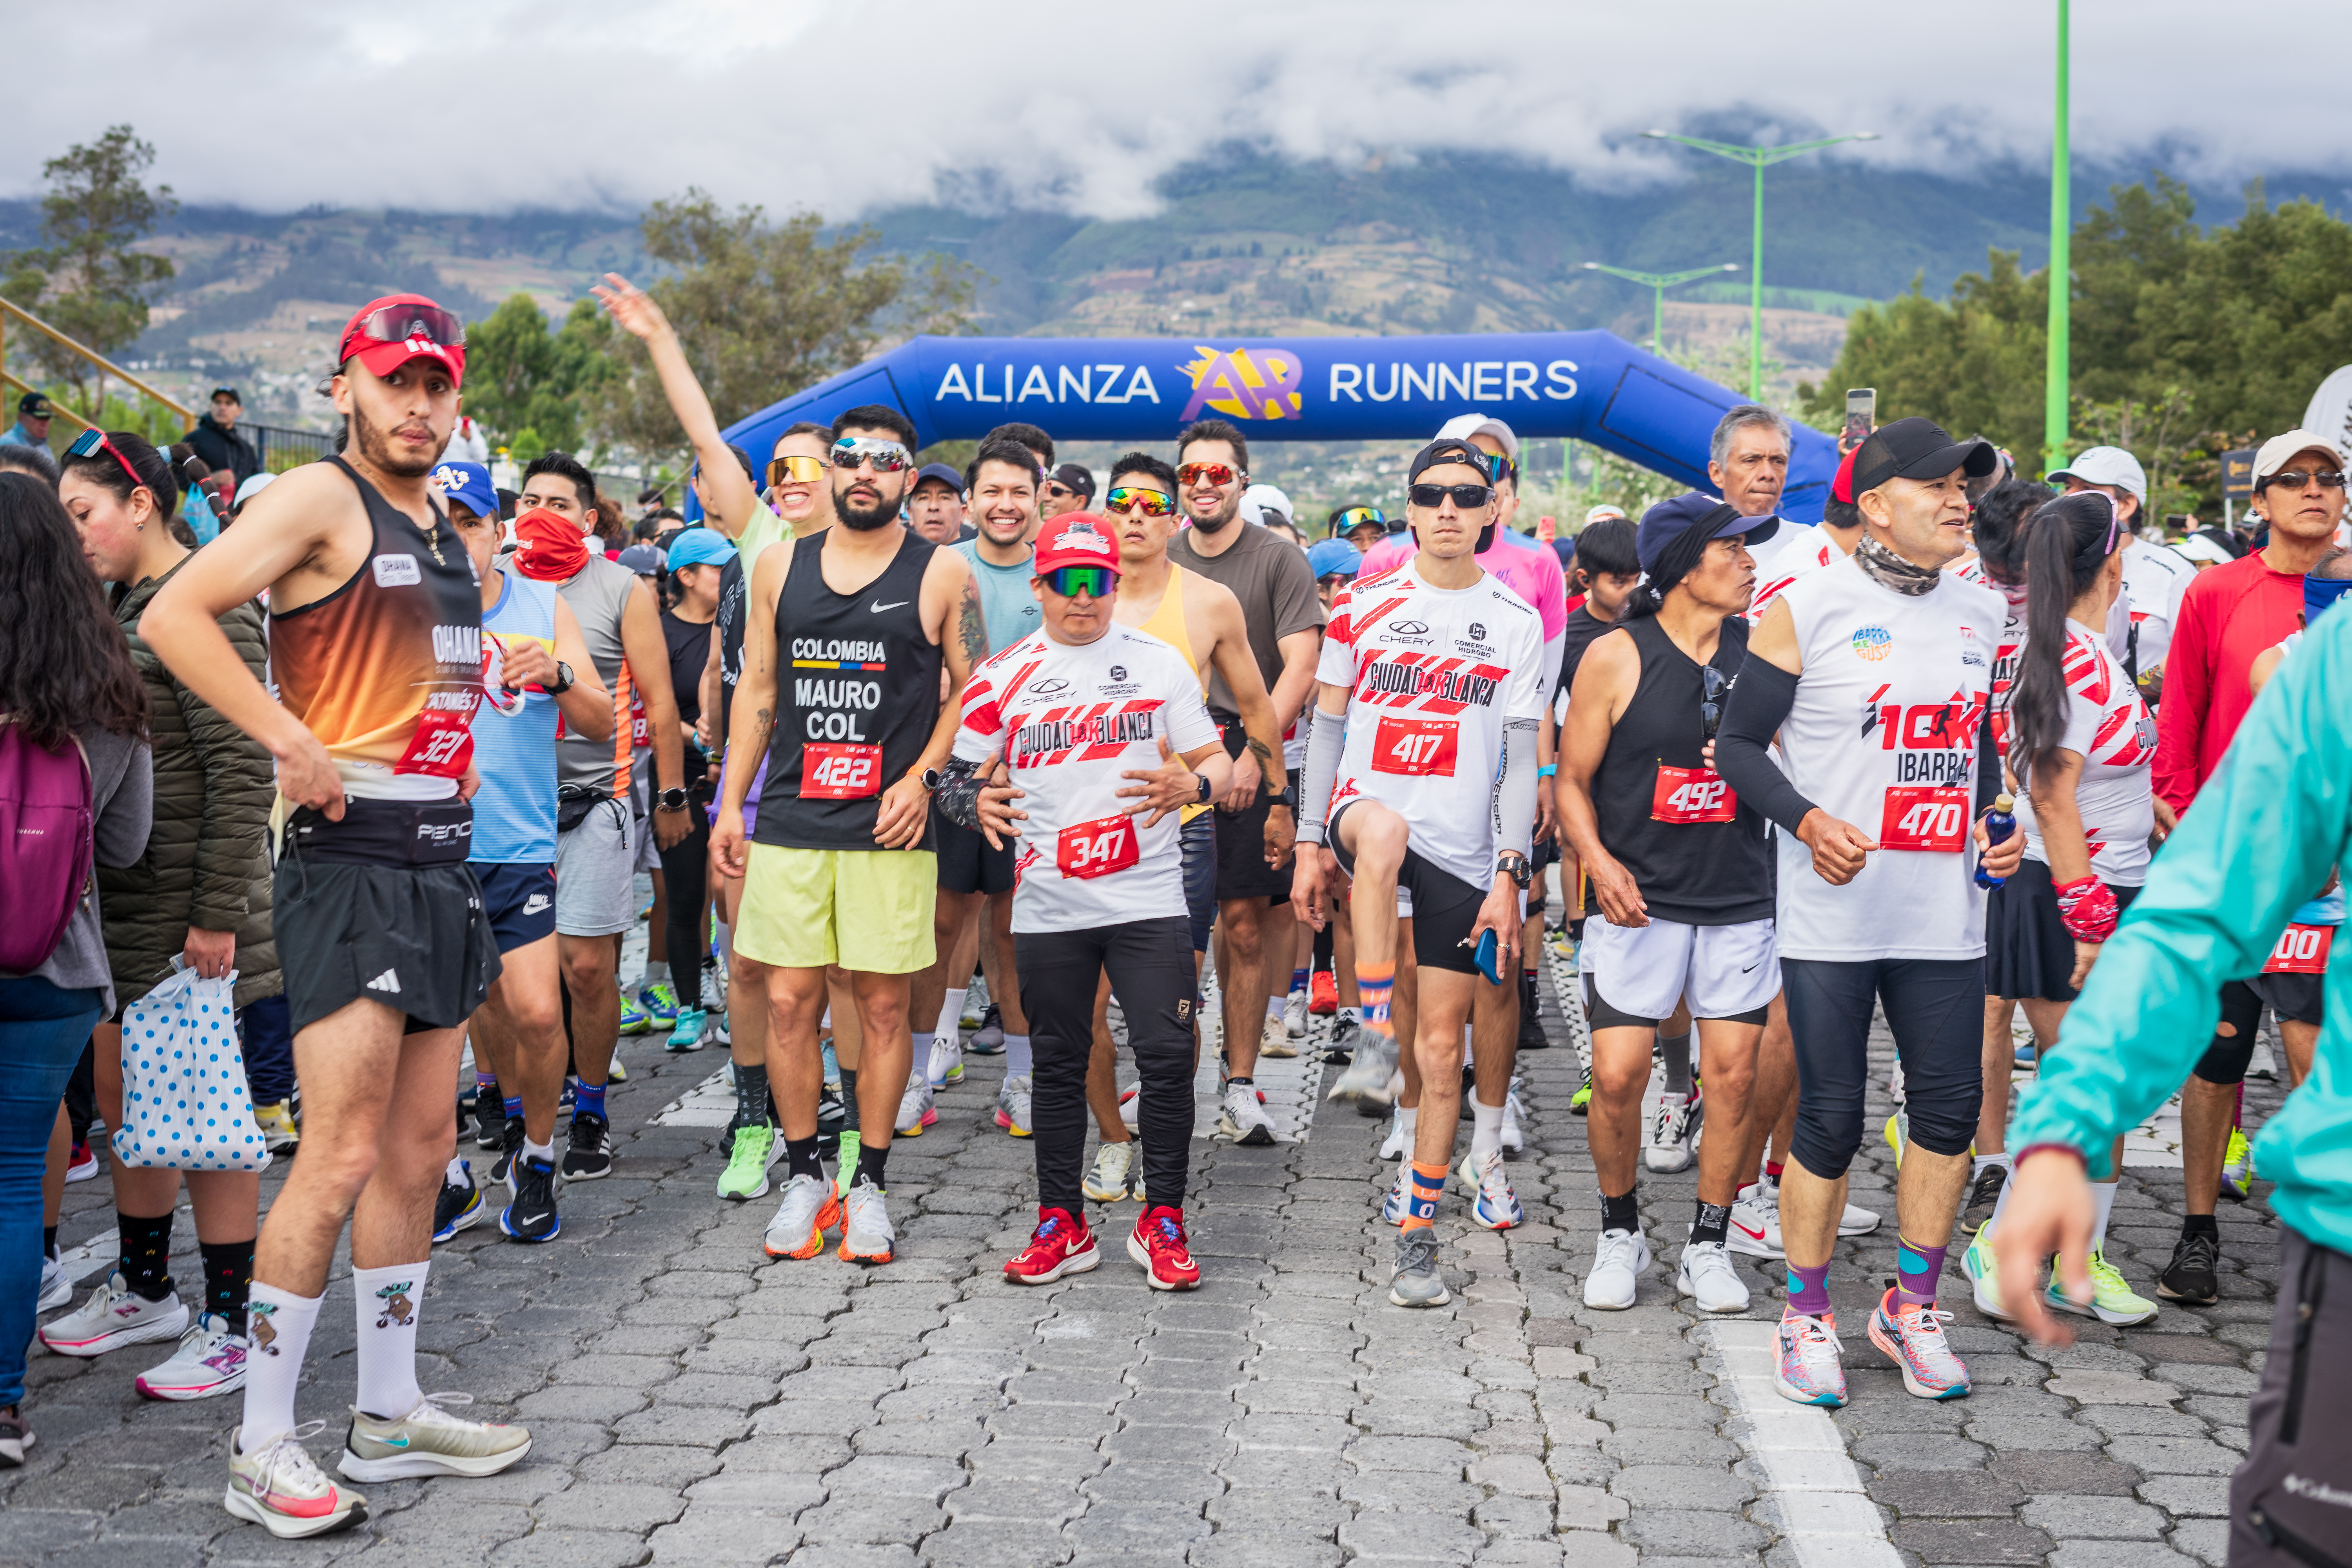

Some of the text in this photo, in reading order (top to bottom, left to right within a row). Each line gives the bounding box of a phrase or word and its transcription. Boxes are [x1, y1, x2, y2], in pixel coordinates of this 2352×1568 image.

[935, 363, 1160, 404] ALIANZA
[1329, 360, 1579, 403] RUNNERS
[436, 465, 470, 491] A's
[380, 559, 412, 572] OHANA
[1365, 578, 1399, 590] THUNDER
[1501, 596, 1533, 615] THUNDER
[432, 624, 482, 665] OHANA
[792, 638, 886, 662] COLOMBIA
[1379, 635, 1435, 646] CHERY
[1455, 639, 1497, 653] COMERCIAL
[1853, 628, 1892, 645] IBARRA
[1853, 640, 1869, 649] ME
[1458, 646, 1491, 658] HIDROBO
[795, 678, 881, 710] MAURO
[1021, 690, 1078, 706] CHERY
[1098, 682, 1143, 691] COMERCIAL
[1370, 662, 1423, 696] CIUDAD
[1440, 671, 1497, 707] BLANCA
[806, 711, 865, 741] COL
[1019, 719, 1073, 755] CIUDAD
[1095, 711, 1153, 745] BLANCA
[1877, 704, 1984, 750] 10K
[411, 729, 470, 765] 321
[1391, 734, 1444, 764] 417
[812, 757, 872, 788] 422
[1897, 753, 1968, 782] IBARRA
[1666, 780, 1727, 811] 492
[1898, 803, 1962, 837] 470
[1071, 828, 1126, 869] 347
[528, 893, 549, 906] NIKE
[2267, 929, 2321, 960] 00
